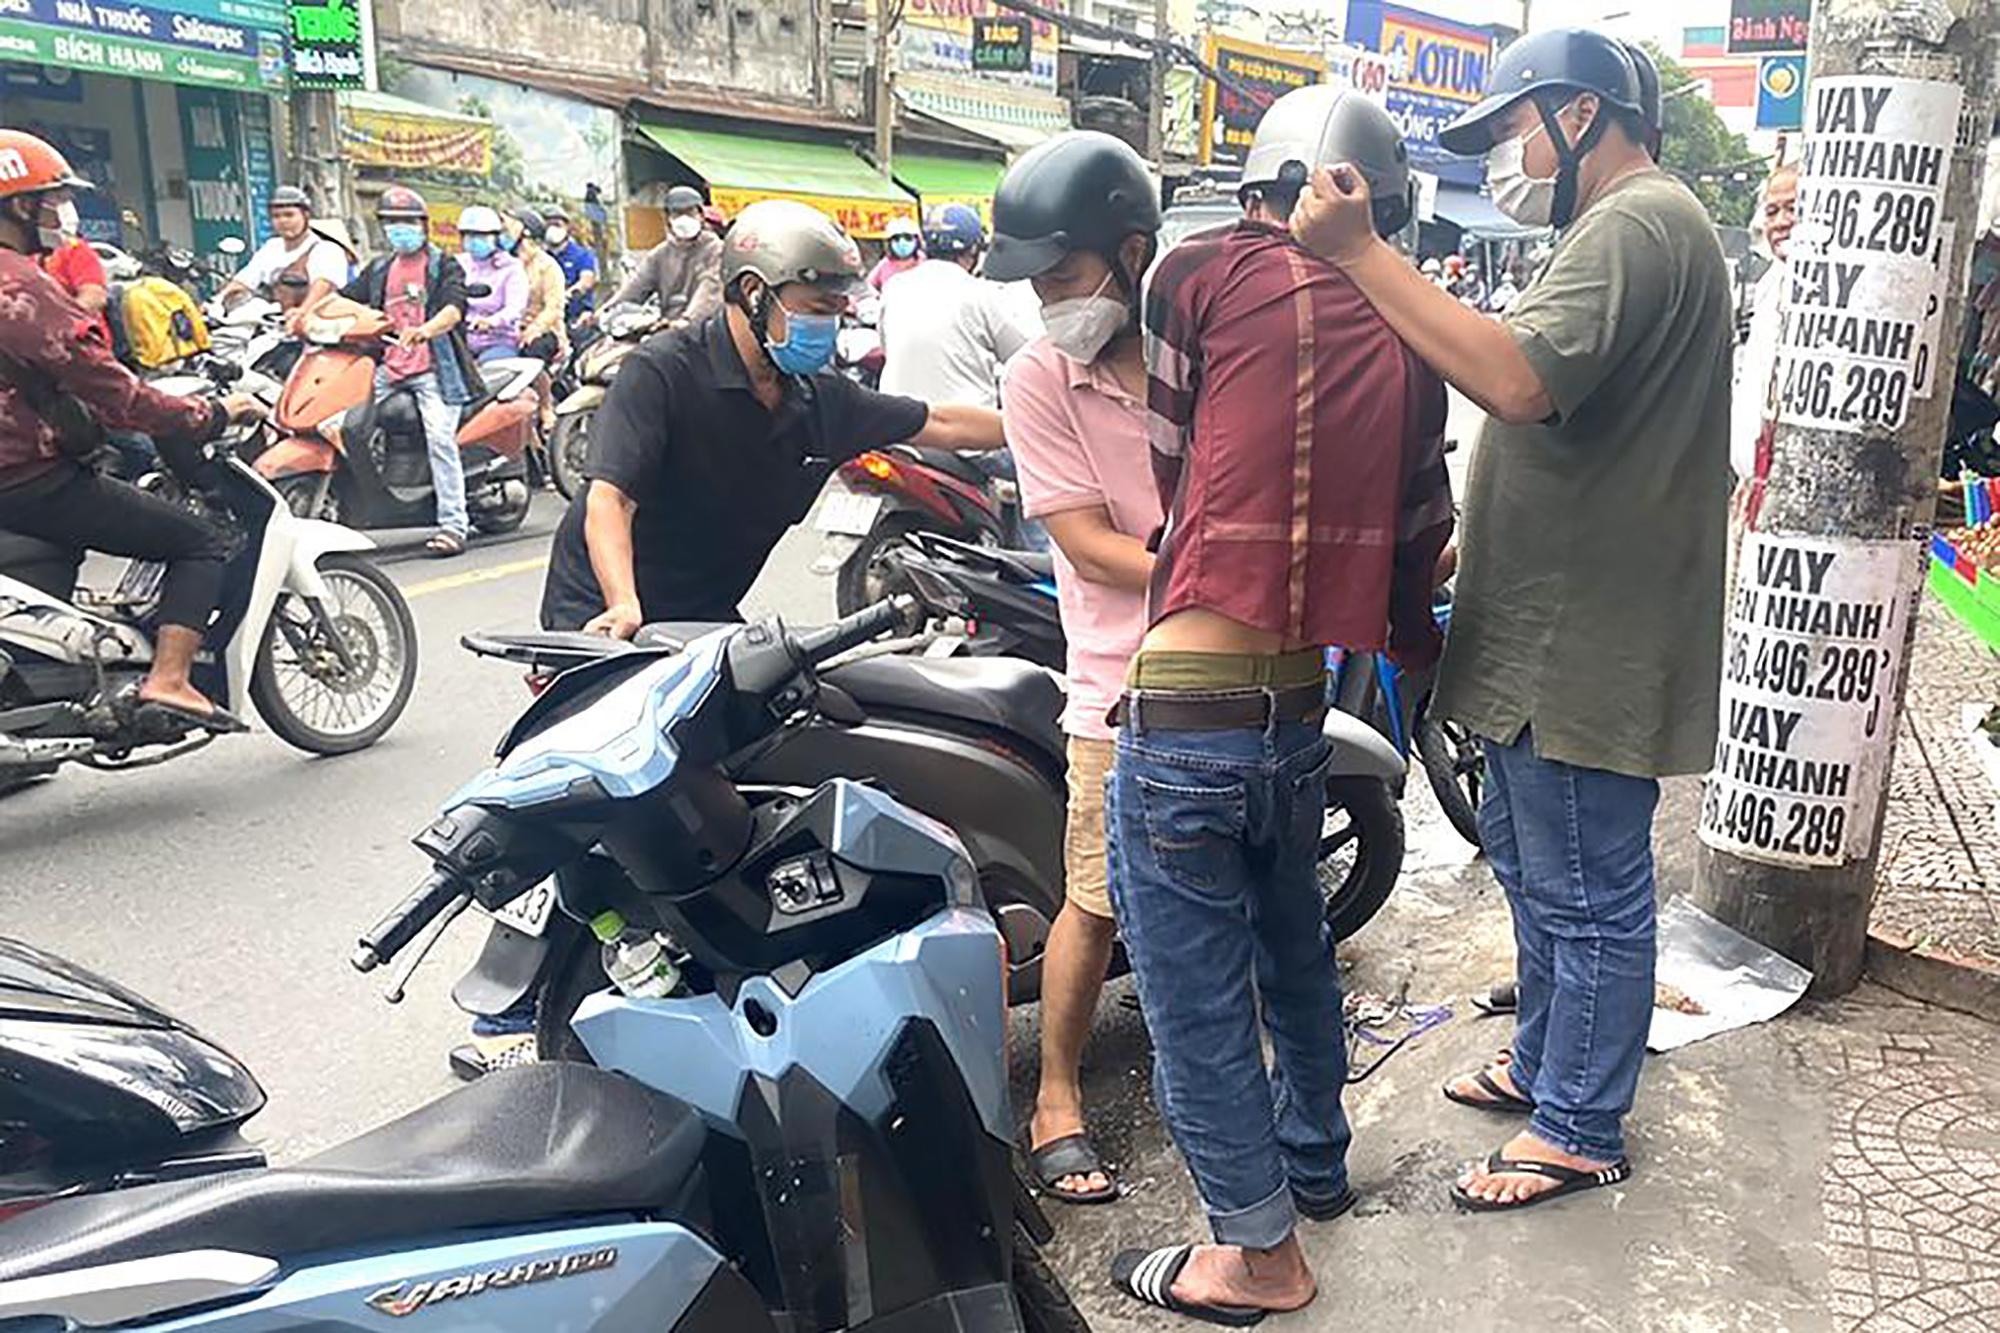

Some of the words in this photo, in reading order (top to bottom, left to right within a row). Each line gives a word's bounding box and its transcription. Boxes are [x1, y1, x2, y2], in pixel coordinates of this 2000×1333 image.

[54, 33, 105, 63] BÍCH
[106, 43, 163, 72] HẠNH
[1407, 36, 1485, 95] JOTUN
[1815, 86, 1893, 134] VAY
[1819, 139, 1944, 187] NHANH
[1790, 259, 1866, 310] VAY
[1794, 312, 1915, 361] NHANH
[1756, 543, 1837, 595] VAY
[1763, 594, 1884, 639] NHANH
[1728, 698, 1803, 753] VAY
[1734, 746, 1851, 798] NHANH
